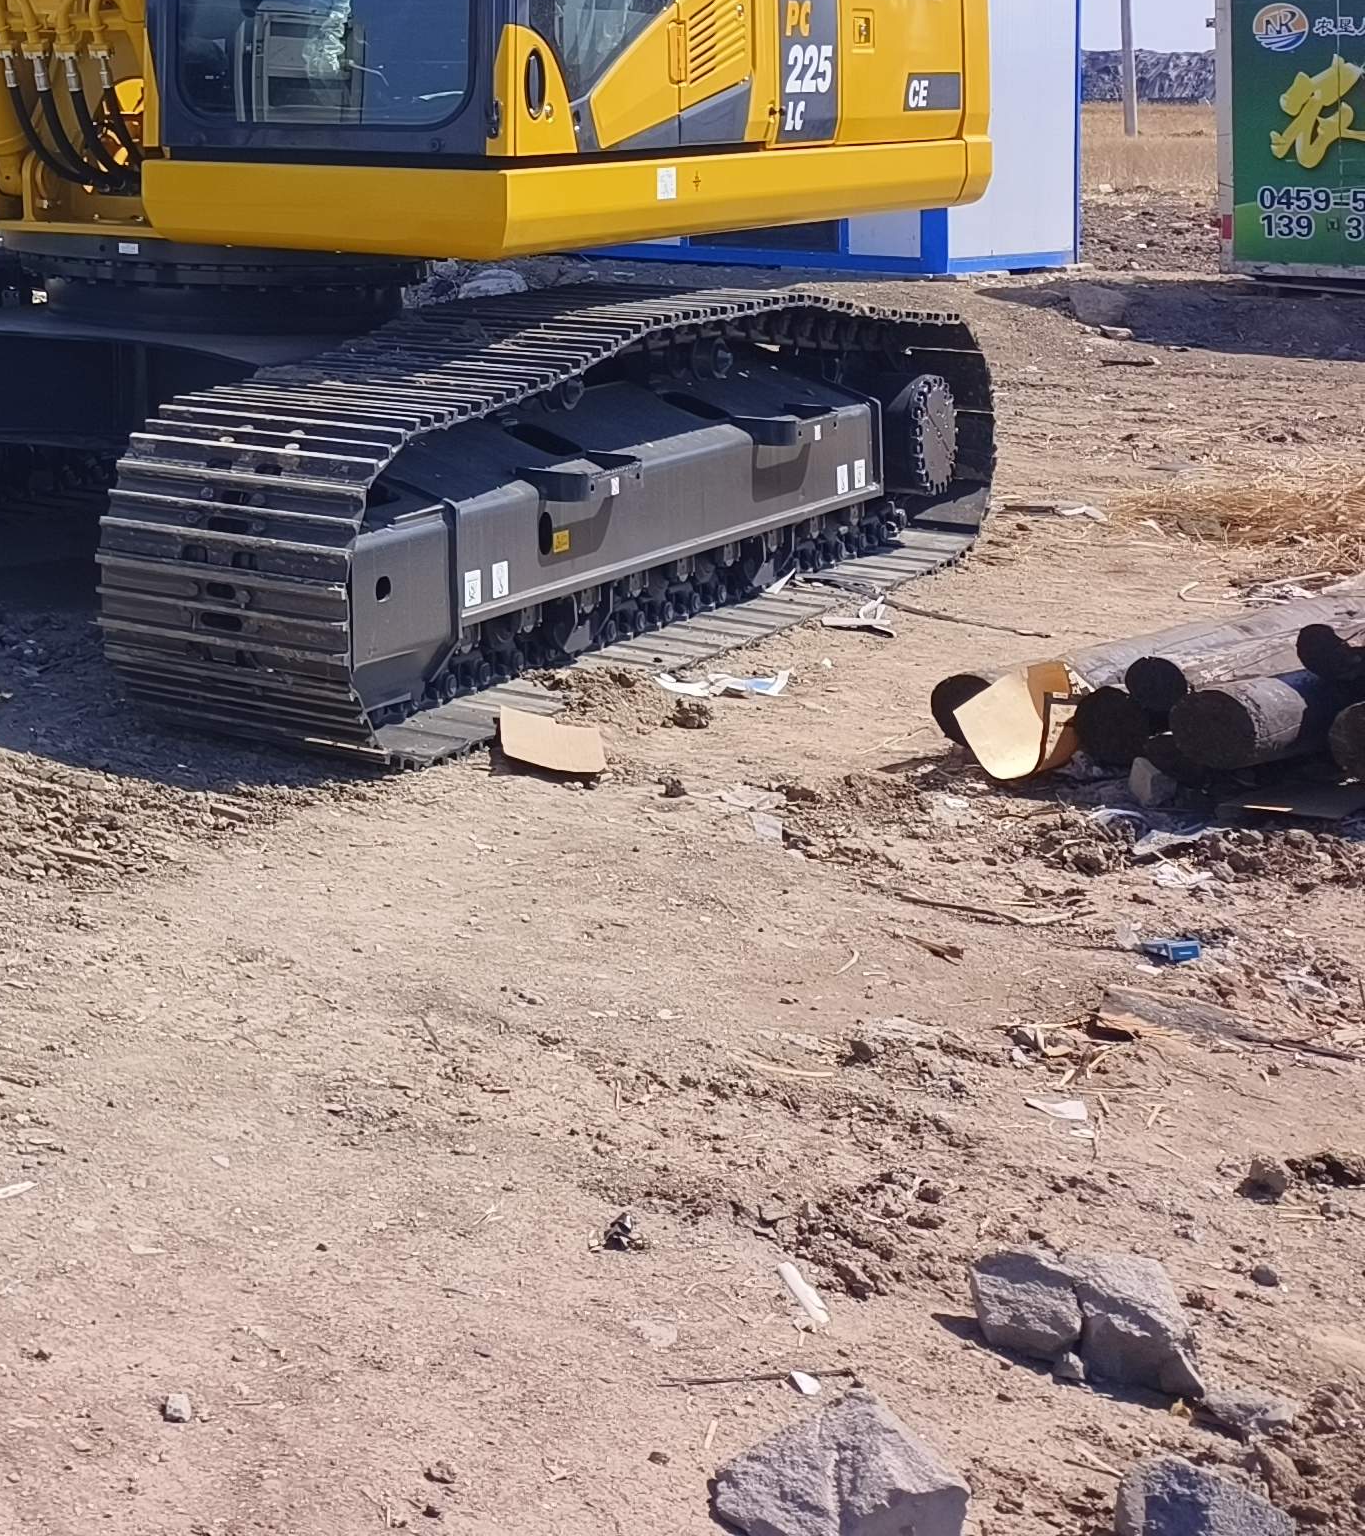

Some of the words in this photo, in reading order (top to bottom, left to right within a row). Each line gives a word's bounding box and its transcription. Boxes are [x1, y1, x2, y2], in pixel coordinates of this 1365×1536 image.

[785, 0, 812, 37] PC
[785, 44, 833, 94] 225
[908, 79, 928, 108] CE
[784, 100, 806, 131] LC
[1260, 213, 1315, 239] 139
